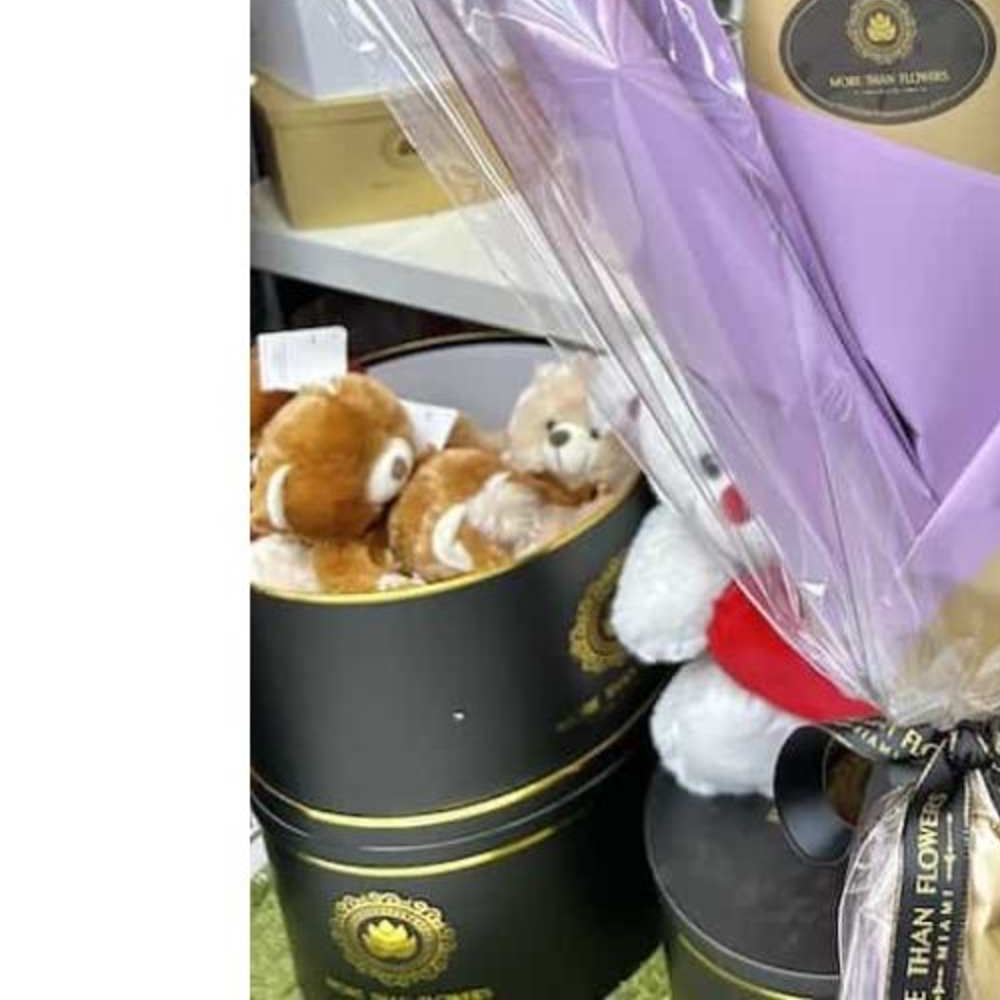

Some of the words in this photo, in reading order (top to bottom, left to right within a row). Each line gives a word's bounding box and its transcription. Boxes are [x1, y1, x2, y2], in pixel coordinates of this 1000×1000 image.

[829, 74, 862, 88] MORE
[899, 70, 950, 85] FLOWERS
[916, 792, 948, 895] FLOWERS
[907, 907, 935, 977] THAN
[936, 889, 955, 960] MIAMI
